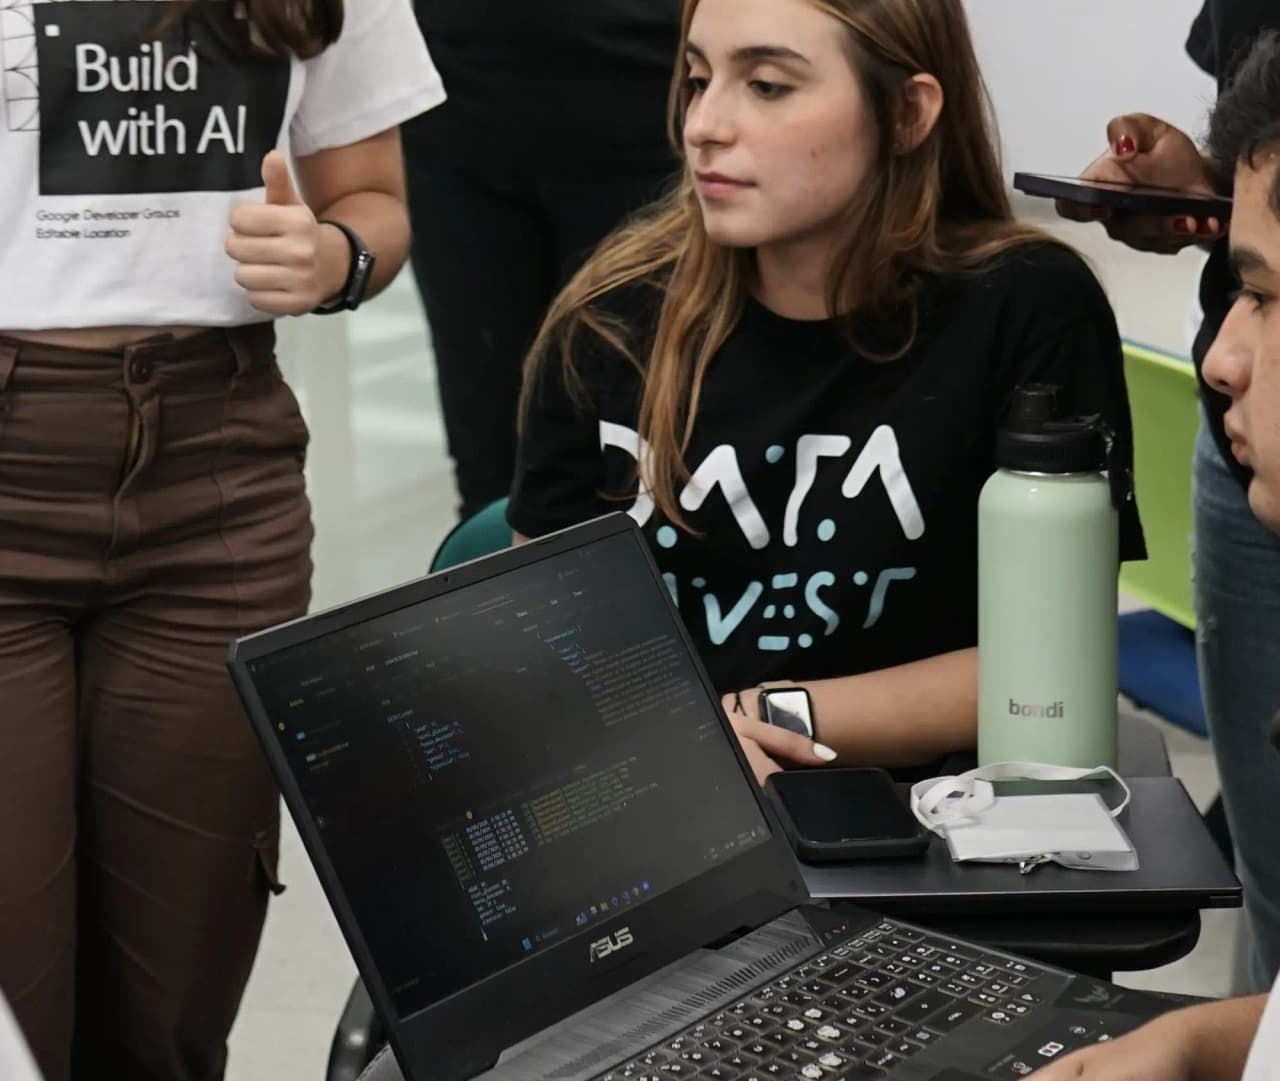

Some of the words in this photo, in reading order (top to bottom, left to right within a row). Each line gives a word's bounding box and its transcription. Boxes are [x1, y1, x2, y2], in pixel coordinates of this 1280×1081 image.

[75, 40, 198, 92] Build
[78, 104, 186, 156] with
[196, 105, 247, 154] AI
[36, 209, 80, 223] Google
[84, 209, 139, 221] Developer
[143, 208, 181, 220] Groups
[84, 228, 130, 239] Location
[662, 567, 914, 651] VEST
[1009, 698, 1064, 719] bondi
[590, 926, 634, 964] ASUS
